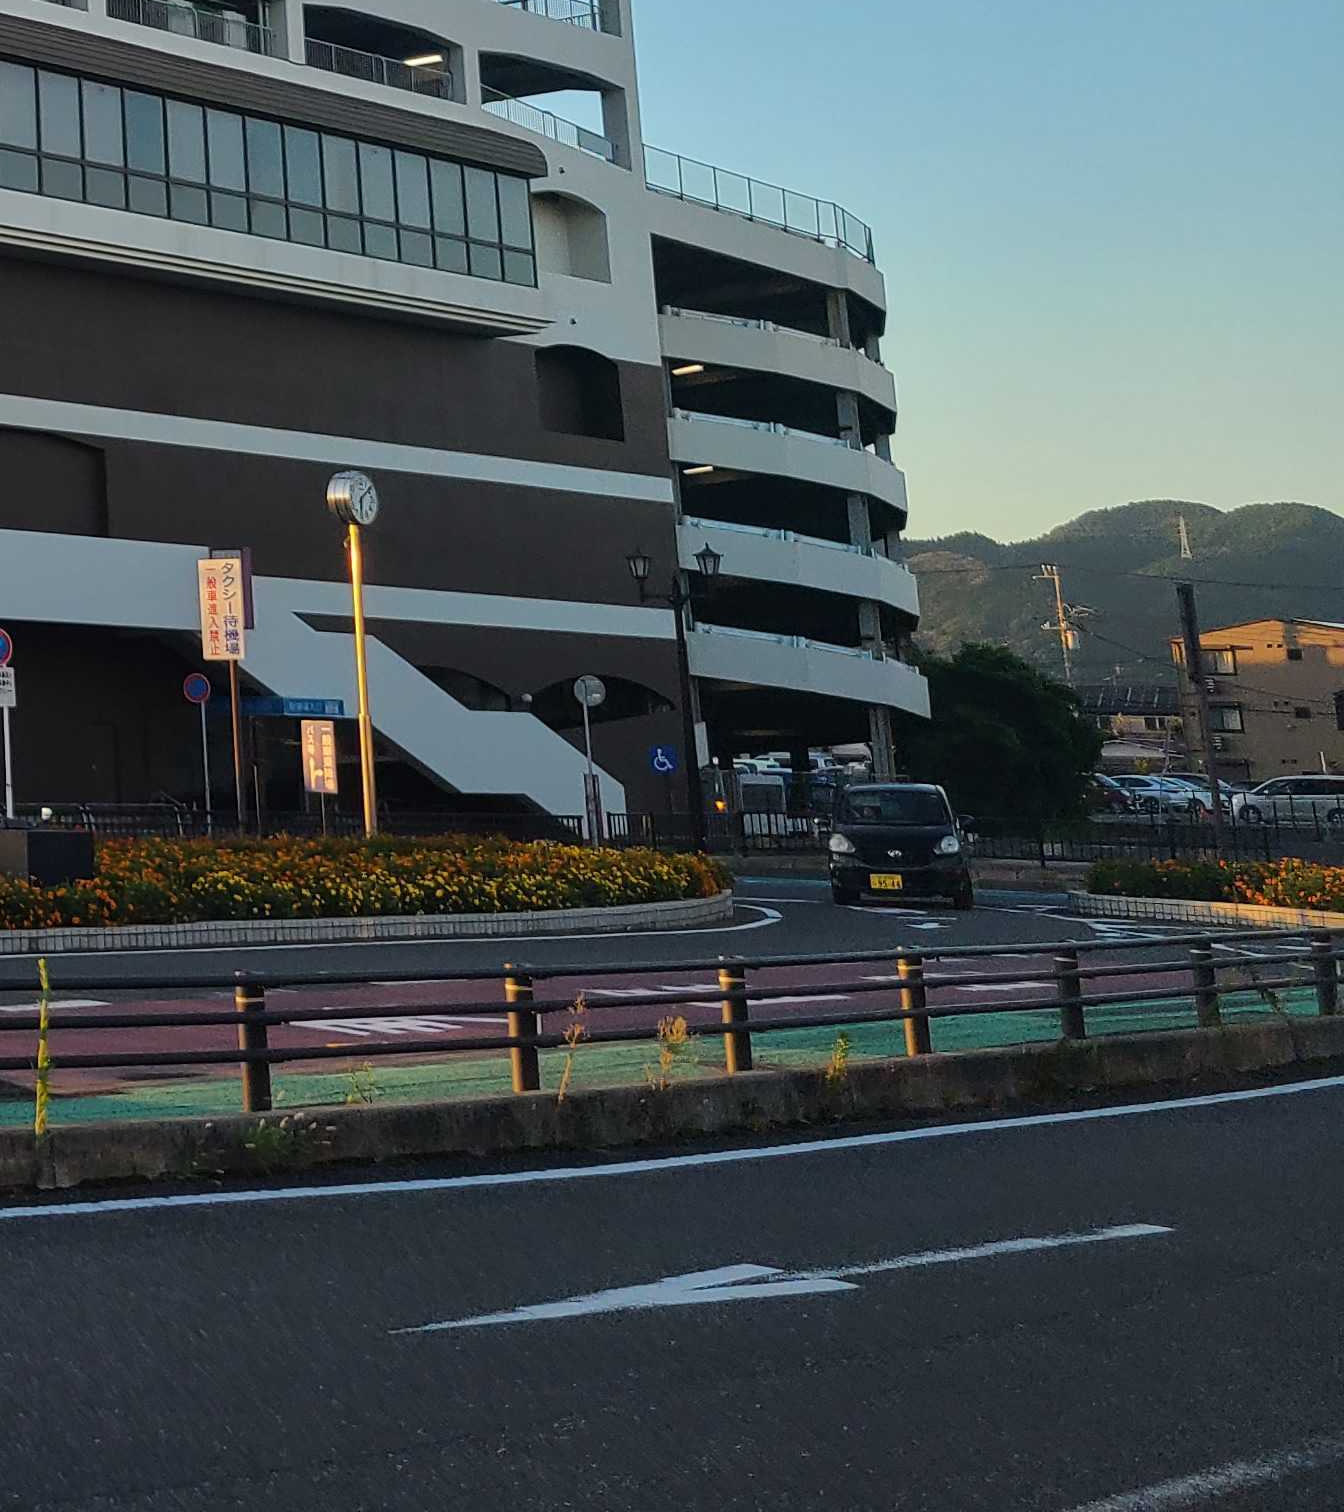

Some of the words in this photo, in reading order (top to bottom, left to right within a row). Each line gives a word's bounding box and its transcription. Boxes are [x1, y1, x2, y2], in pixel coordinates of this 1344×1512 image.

[220, 562, 241, 655] タクシー待機場
